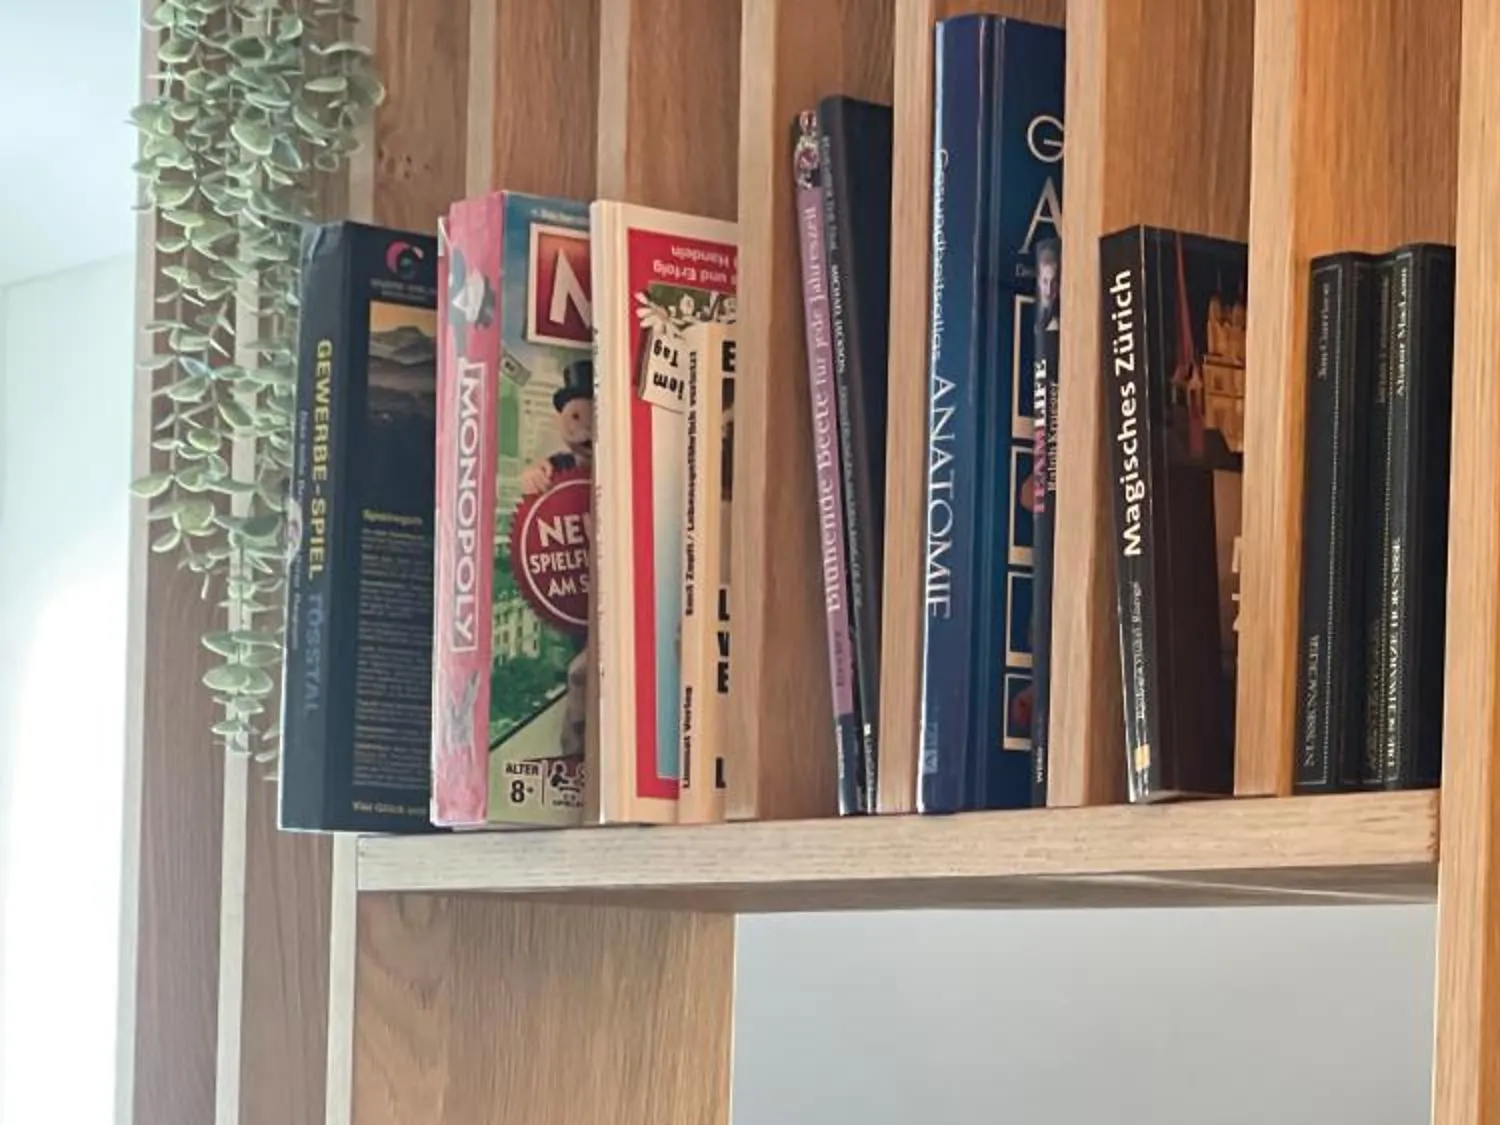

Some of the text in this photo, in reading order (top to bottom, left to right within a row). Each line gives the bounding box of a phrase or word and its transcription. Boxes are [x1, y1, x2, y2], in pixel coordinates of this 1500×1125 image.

[653, 260, 728, 283] und Erfolg
[671, 246, 729, 268] Handeln
[803, 205, 825, 302] Jahreszeit
[831, 264, 843, 316] MICHAEL
[653, 338, 679, 368] Tag
[835, 318, 846, 373] JACKSON
[815, 393, 832, 470] Beete
[1033, 360, 1047, 514] TEAMLIFE
[1111, 270, 1147, 557] Magisches Zürich
[307, 338, 333, 580] GEWERBE-SPIEL
[925, 373, 956, 618] ANATOMIE
[455, 379, 479, 641] MONOPOLY
[548, 577, 577, 598] AM
[1388, 632, 1399, 733] SCHWARZE
[505, 762, 540, 776] ALTER
